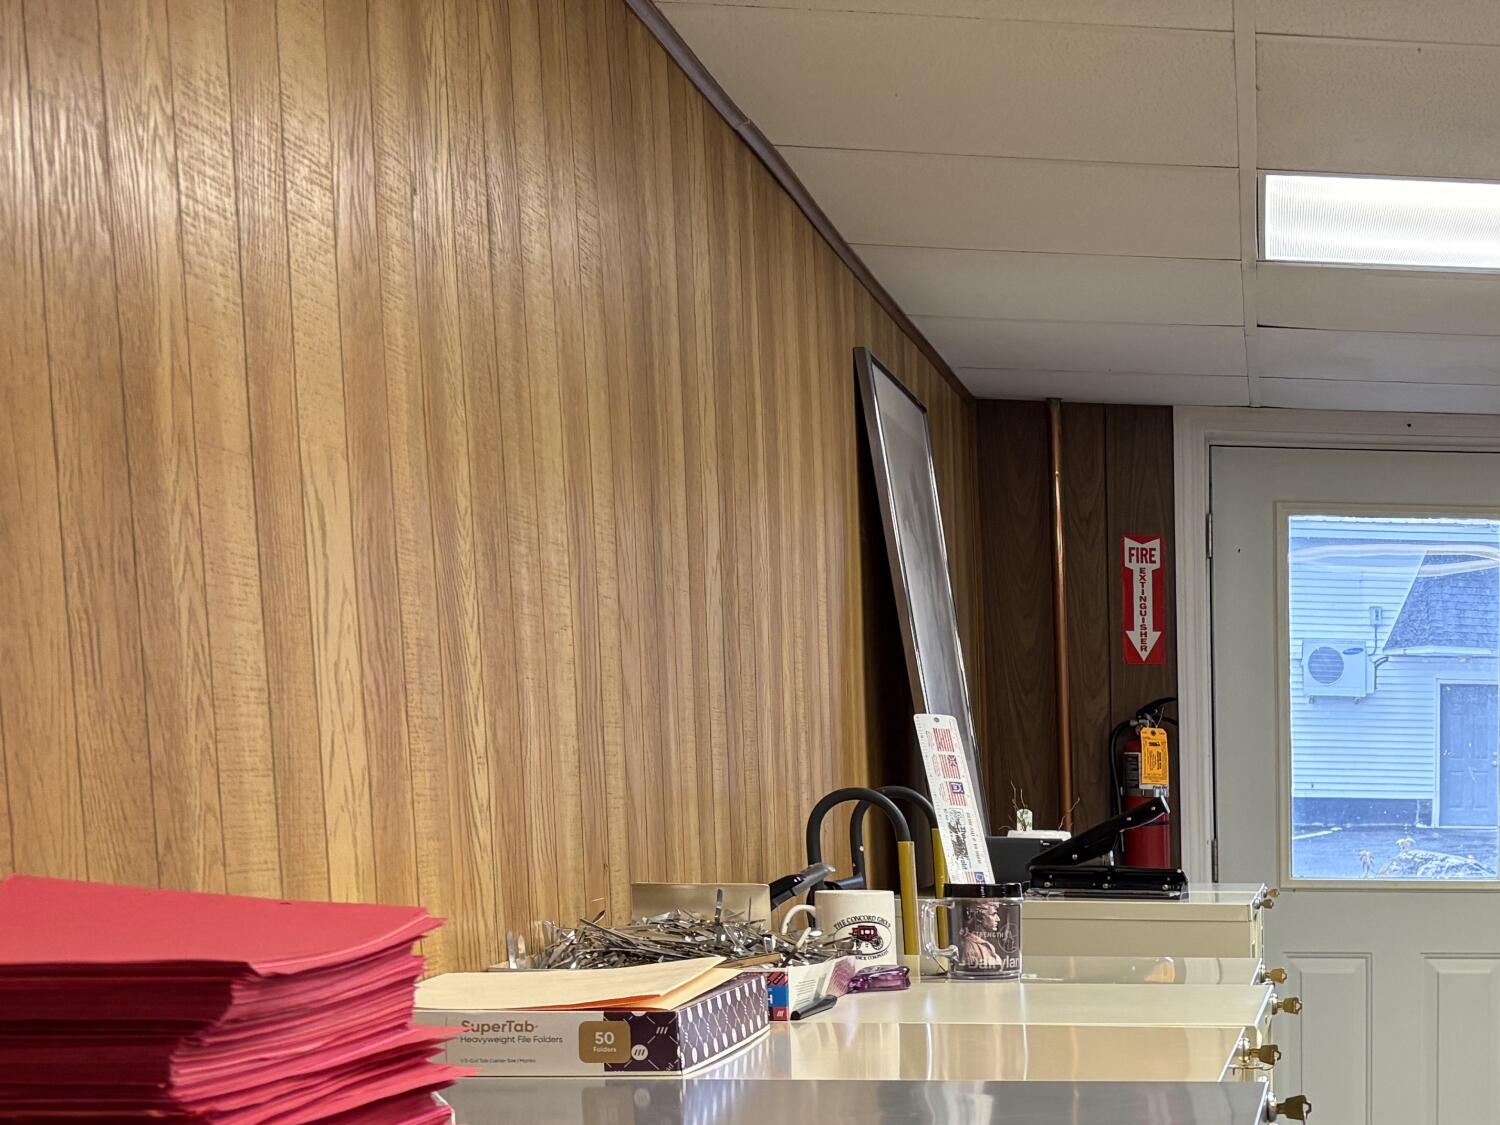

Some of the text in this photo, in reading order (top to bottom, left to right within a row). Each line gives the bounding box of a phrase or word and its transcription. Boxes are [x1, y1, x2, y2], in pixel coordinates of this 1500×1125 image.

[1128, 547, 1157, 564] FIRE
[1139, 567, 1148, 652] EXTINGUISHER
[833, 919, 846, 930] THE
[461, 1020, 535, 1034] SuperTab
[460, 1036, 515, 1044] Heavyweight
[594, 1031, 615, 1045] 50
